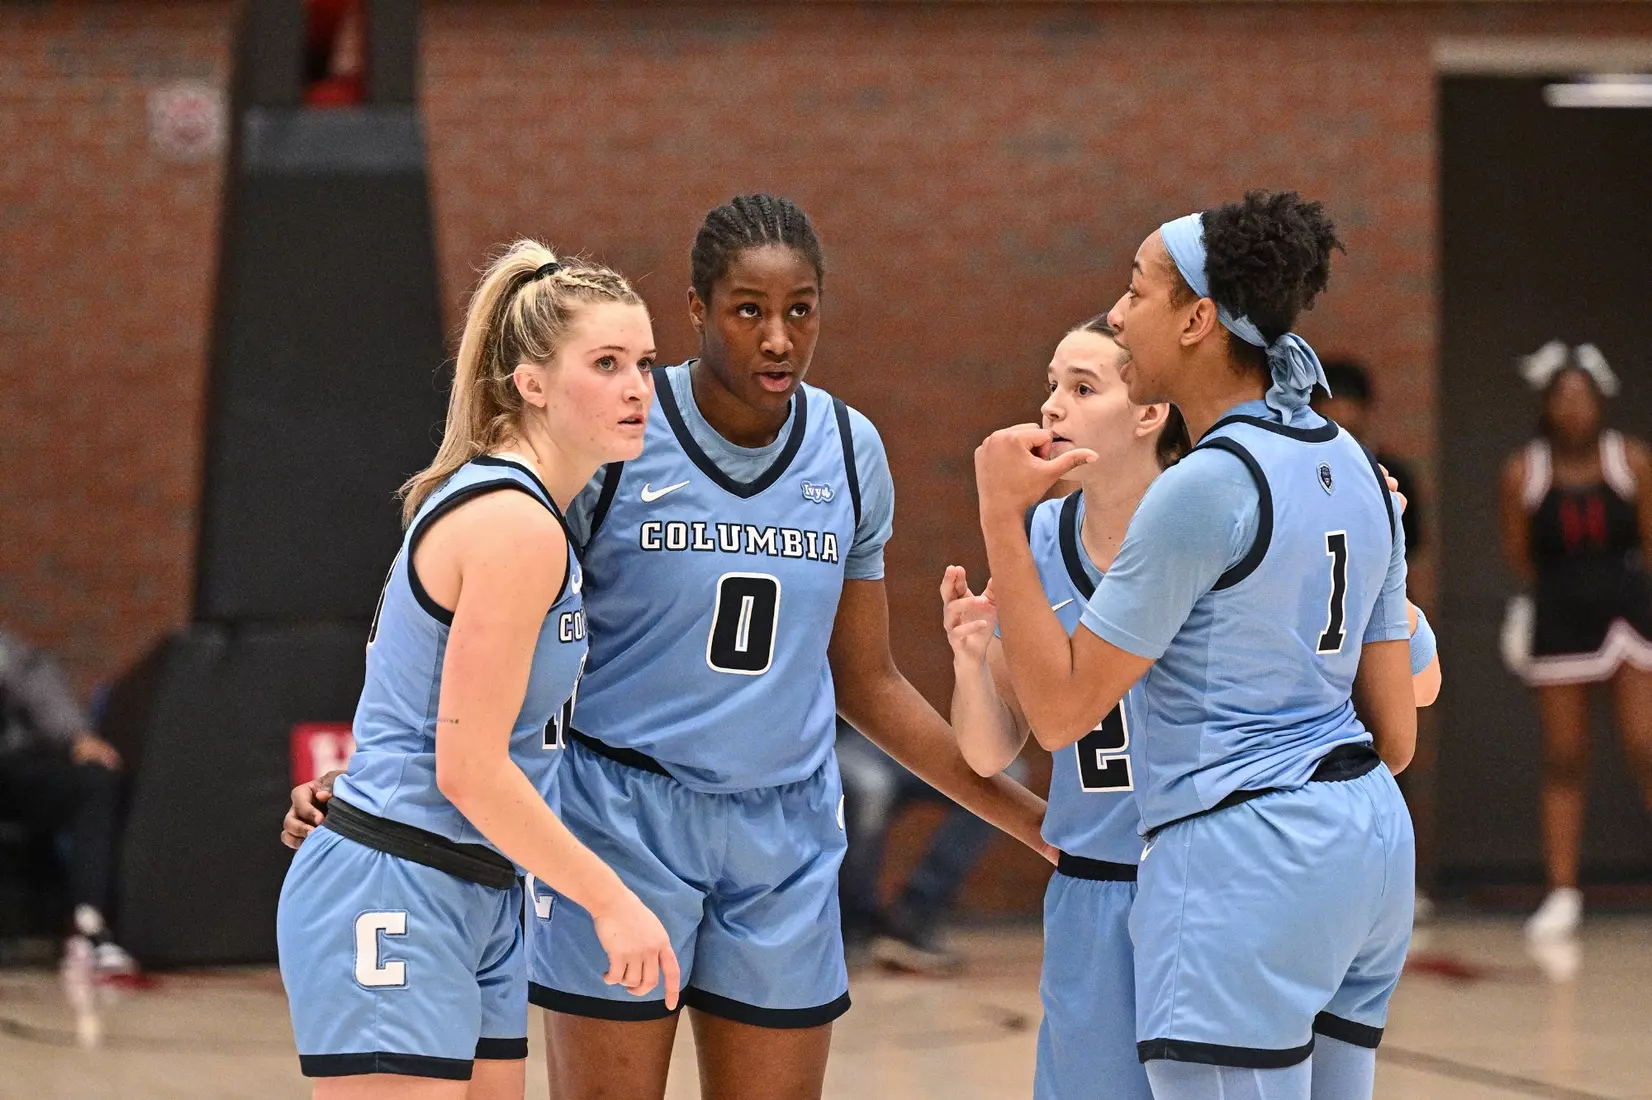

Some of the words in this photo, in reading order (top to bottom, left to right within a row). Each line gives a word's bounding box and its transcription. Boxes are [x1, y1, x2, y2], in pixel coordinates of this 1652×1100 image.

[640, 520, 839, 564] COLUMBIA
[706, 572, 782, 676] 0
[1316, 530, 1349, 654] 1
[1074, 698, 1134, 793] 2
[354, 911, 408, 988] C
